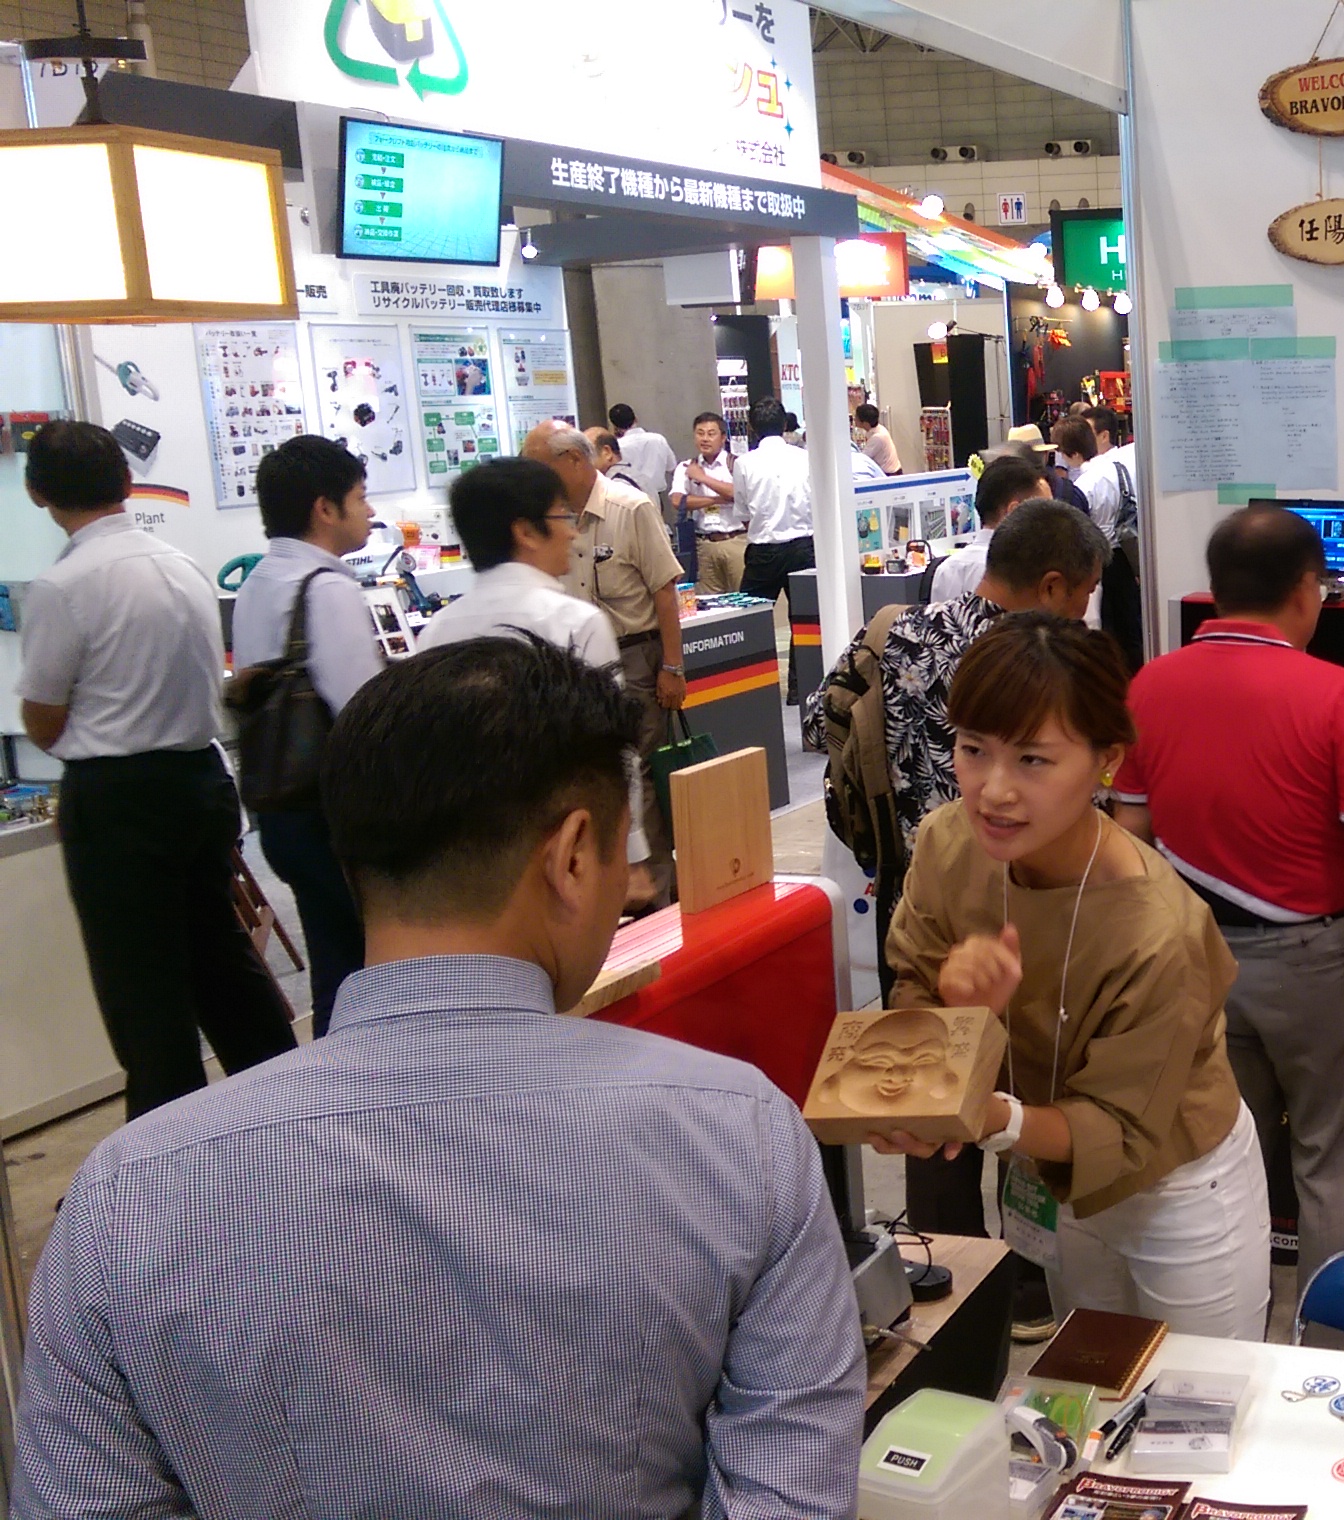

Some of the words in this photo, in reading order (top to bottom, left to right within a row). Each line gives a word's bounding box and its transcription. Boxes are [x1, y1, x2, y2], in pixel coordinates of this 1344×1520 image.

[550, 158, 806, 220] 生産終了機種から最新機種まで取扱中
[1100, 234, 1127, 264] H
[372, 295, 542, 314] リサイクルバッテリー販売代理店様募集中
[781, 364, 800, 381] KTC
[135, 512, 166, 525] Plant
[683, 631, 744, 655] INFORMATION
[890, 1454, 918, 1468] PUSH
